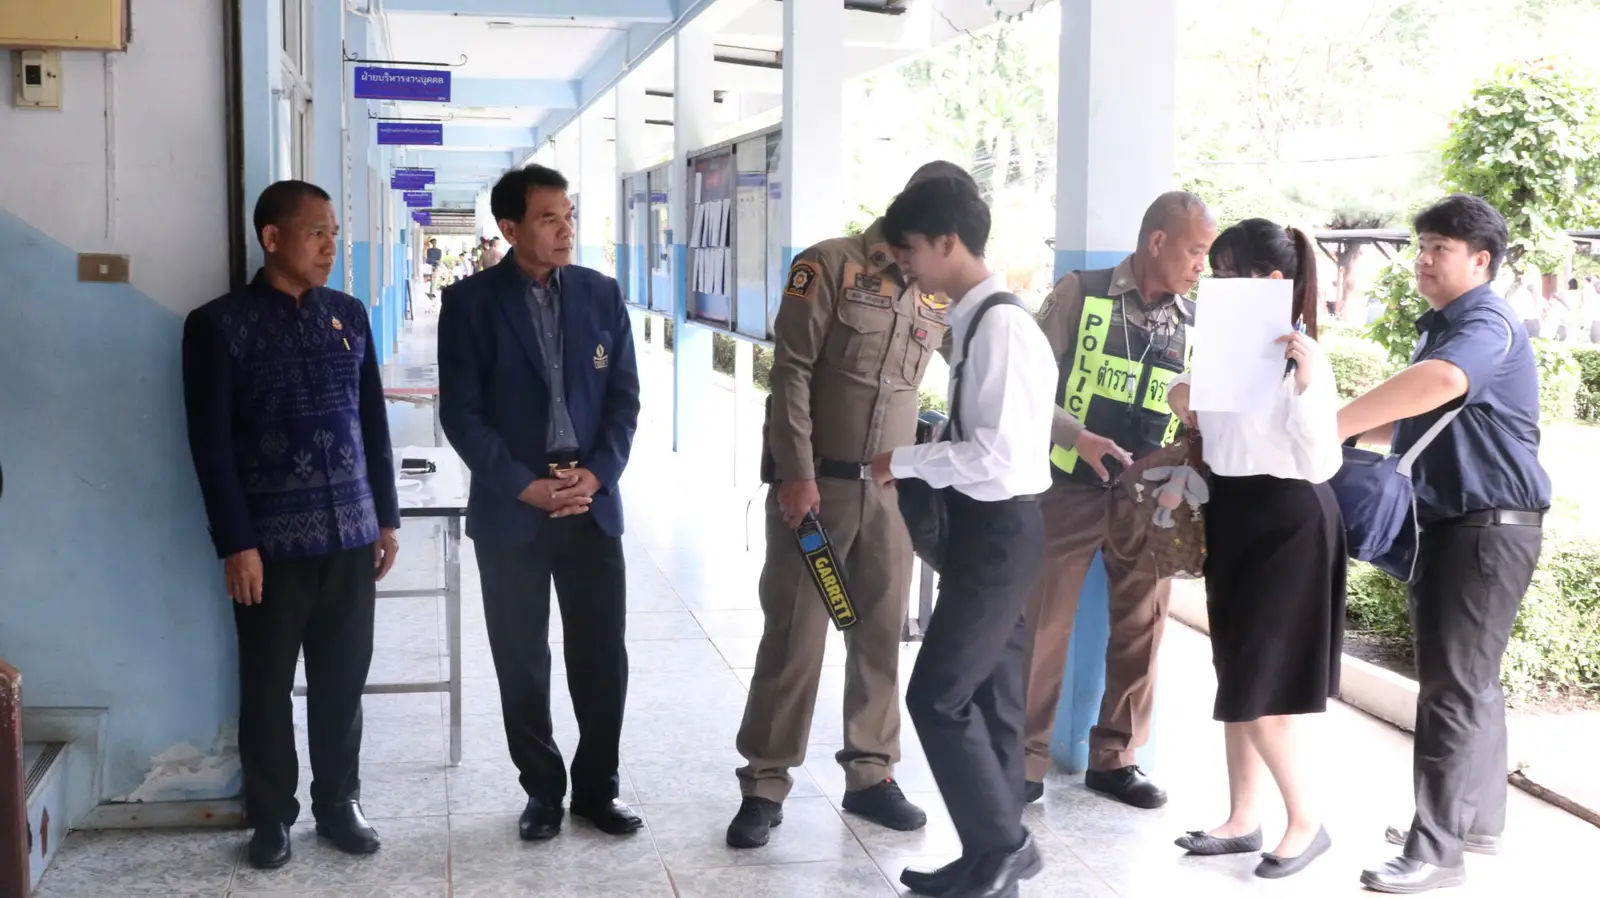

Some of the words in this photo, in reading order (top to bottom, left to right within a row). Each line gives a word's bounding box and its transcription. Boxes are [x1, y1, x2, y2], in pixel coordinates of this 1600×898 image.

[361, 71, 444, 86] ฝ่ายบริหารงานบุคคล
[1069, 313, 1103, 420] POLIC
[1097, 360, 1131, 393] ตำรว
[815, 557, 852, 619] GARRETT
